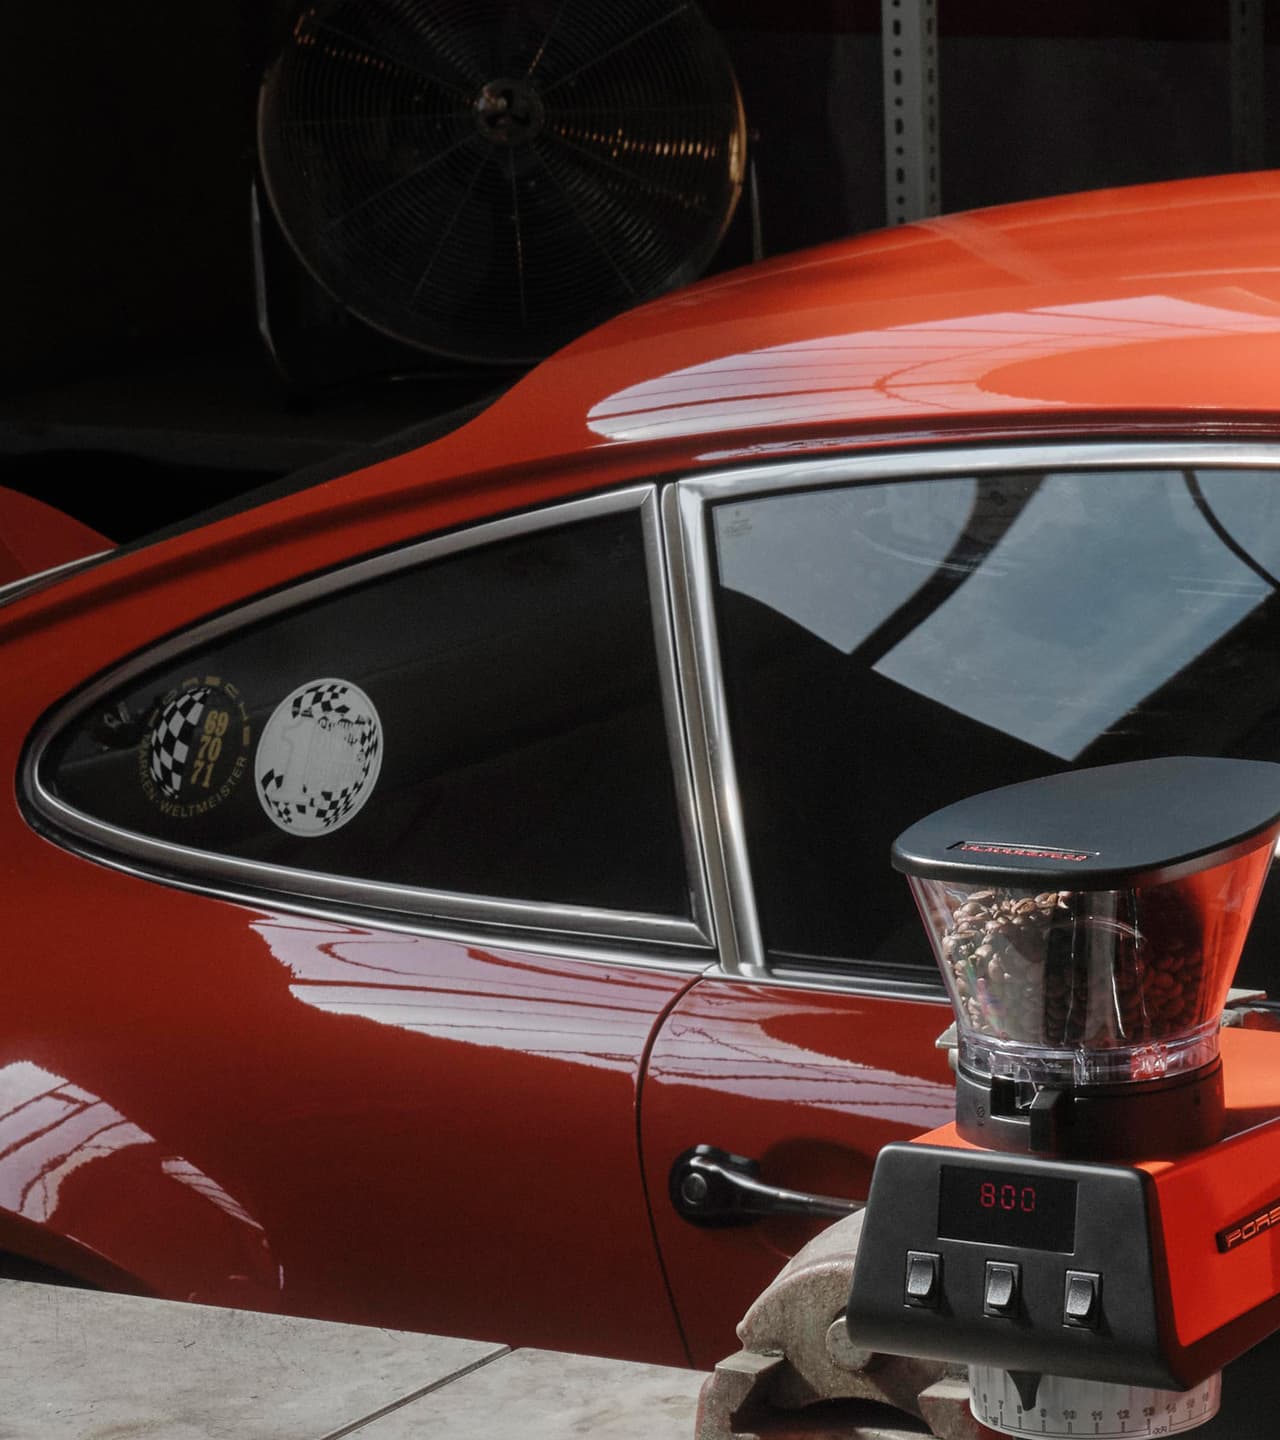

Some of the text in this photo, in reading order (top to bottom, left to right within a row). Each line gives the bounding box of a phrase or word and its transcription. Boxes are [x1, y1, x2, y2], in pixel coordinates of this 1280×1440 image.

[204, 710, 230, 737] 69
[197, 736, 223, 763] 70
[191, 760, 215, 789] 71
[979, 1182, 1037, 1213] 800
